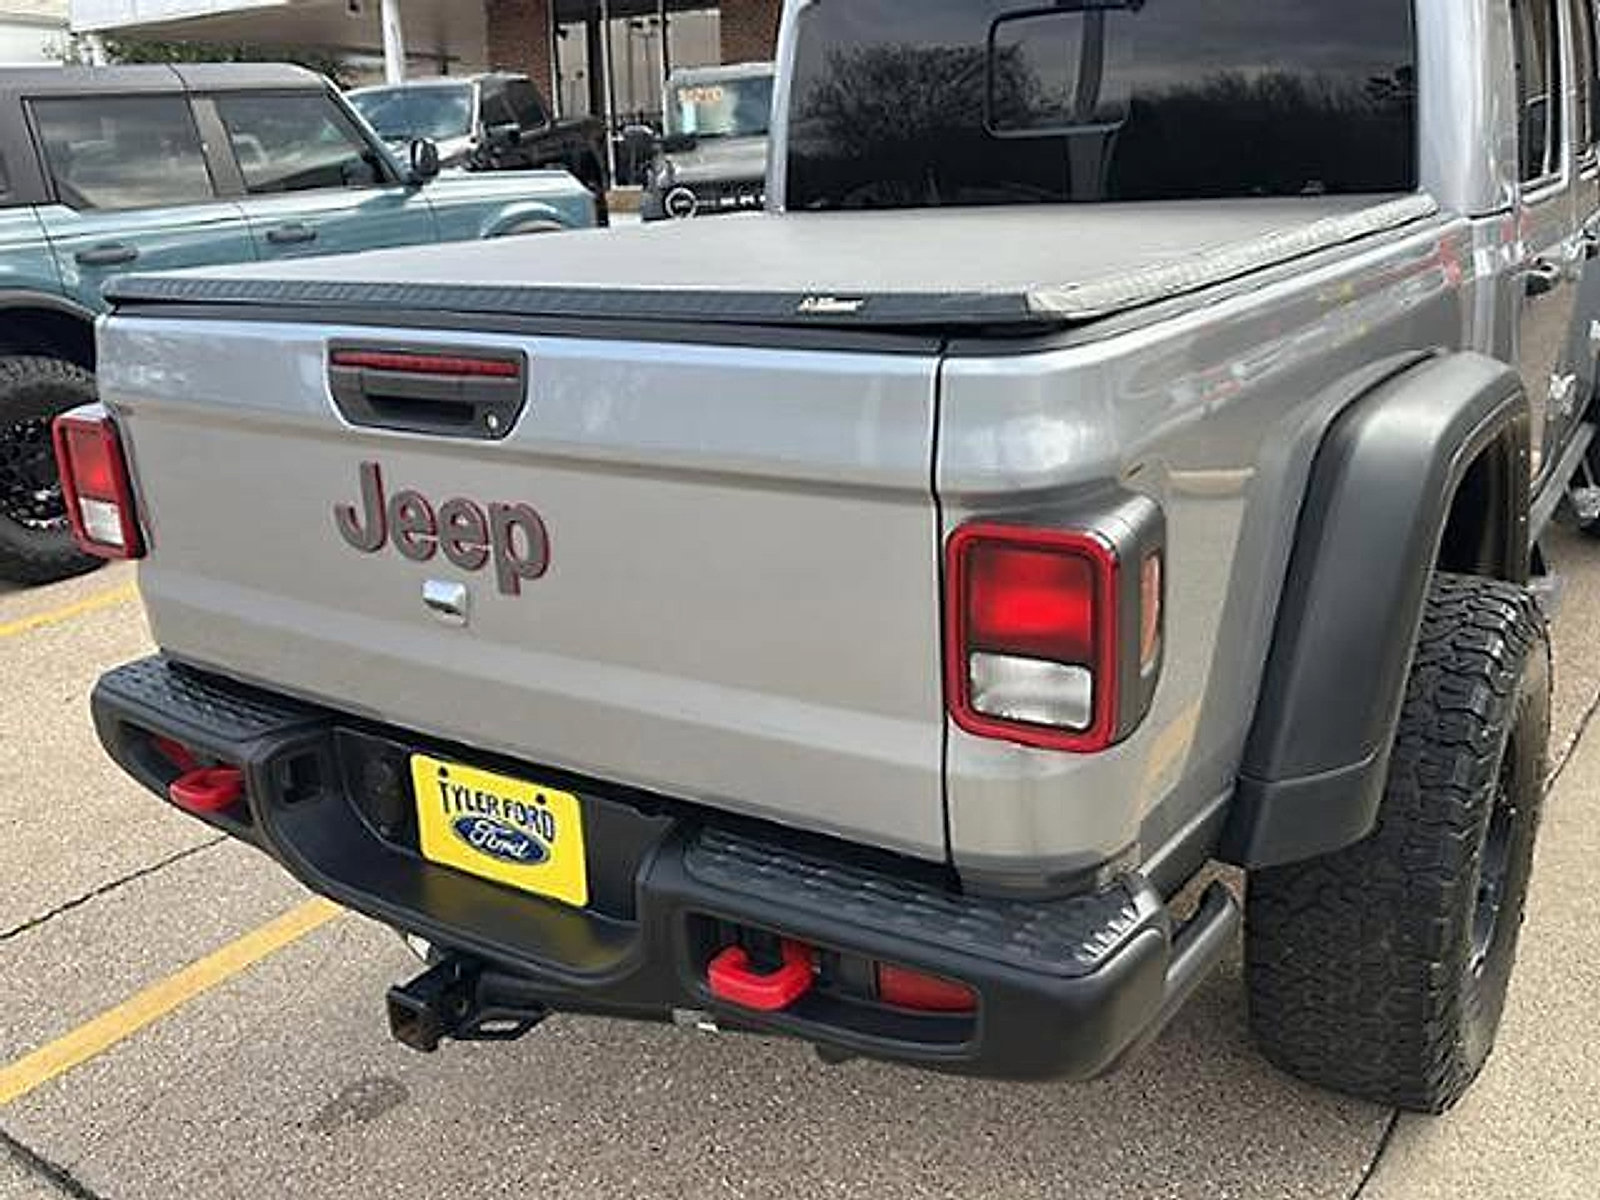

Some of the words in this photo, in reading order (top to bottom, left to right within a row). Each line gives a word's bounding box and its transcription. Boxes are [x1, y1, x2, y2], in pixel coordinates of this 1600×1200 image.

[335, 461, 550, 595] Jeep
[438, 780, 499, 817] TYLER
[503, 800, 555, 843] FORD
[469, 819, 530, 857] Ford
